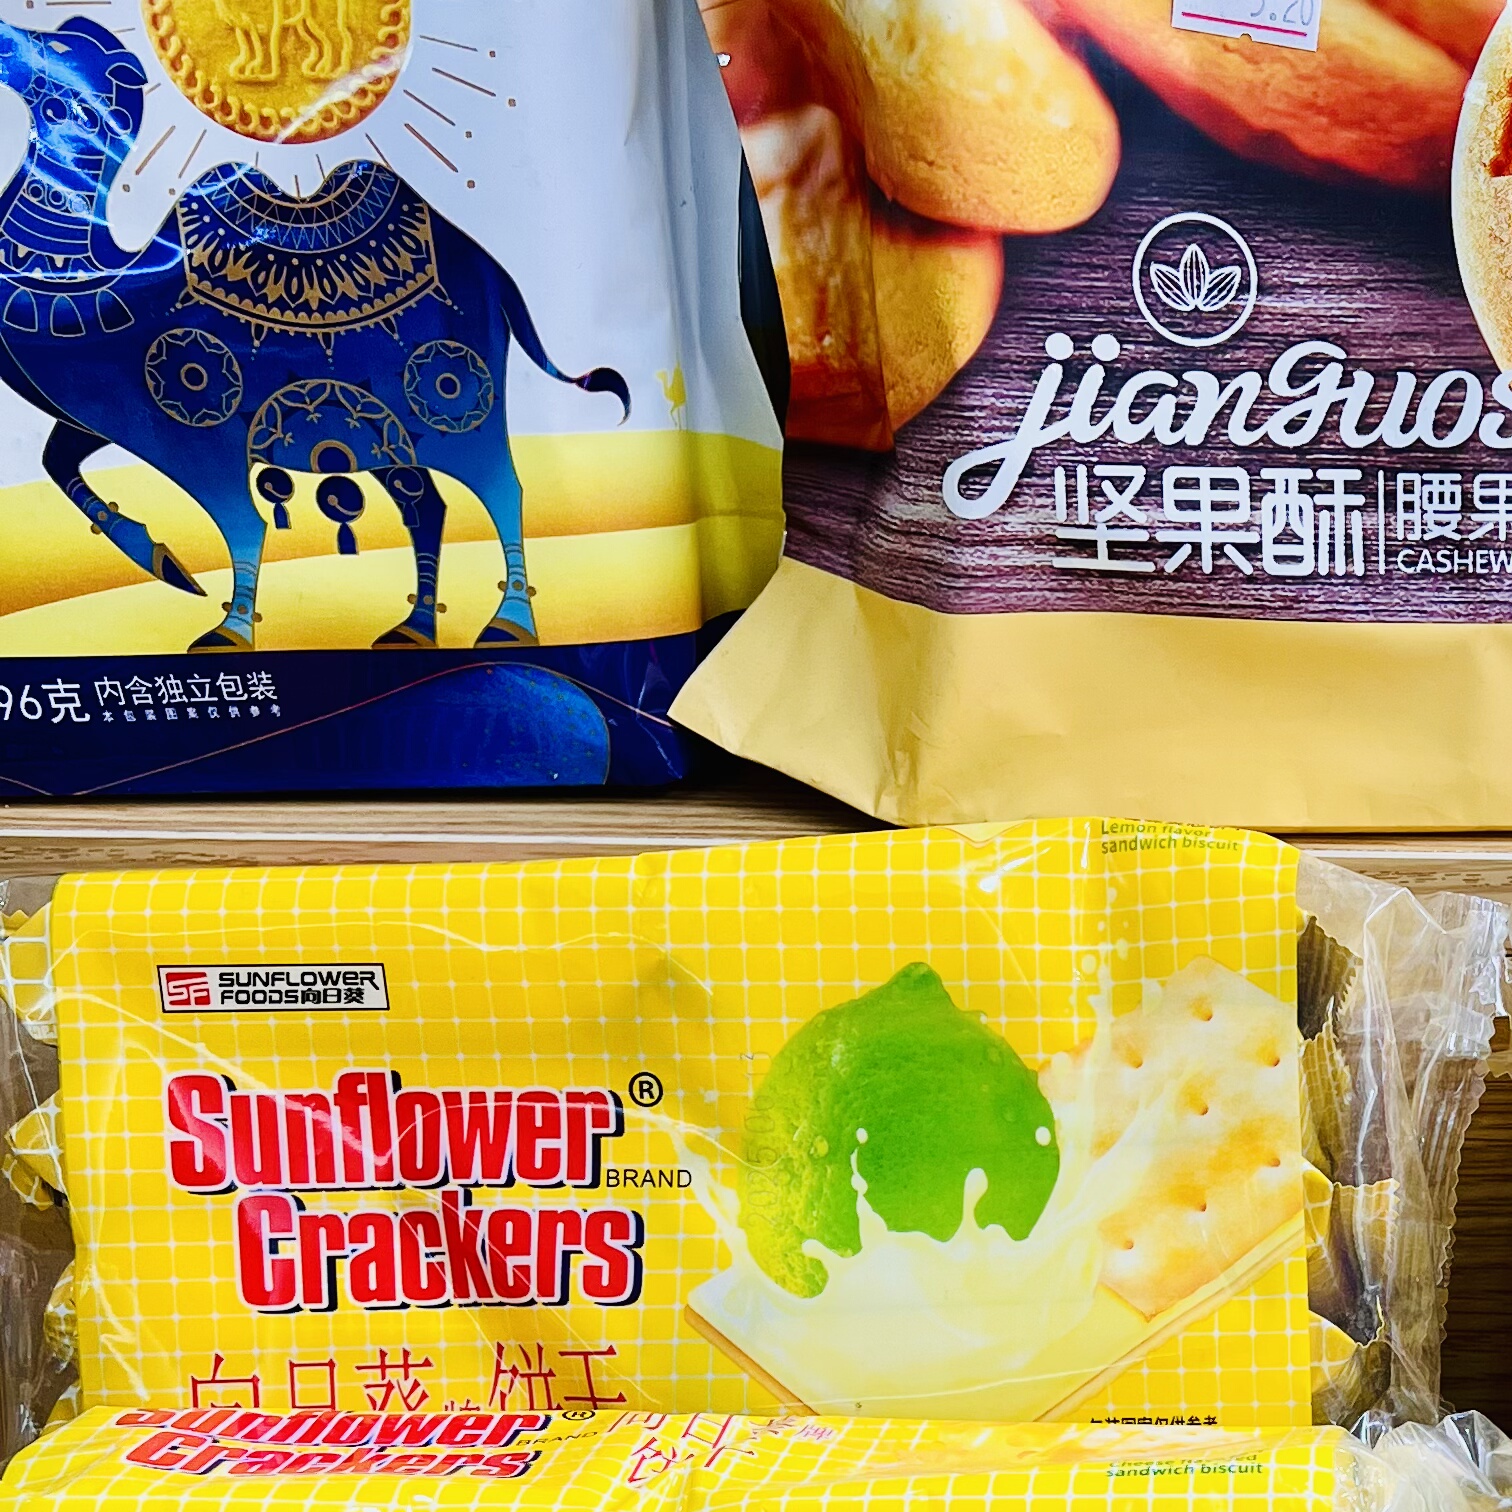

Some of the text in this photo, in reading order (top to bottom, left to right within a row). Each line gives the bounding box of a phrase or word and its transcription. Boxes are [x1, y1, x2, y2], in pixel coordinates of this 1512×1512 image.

[1249, 0, 1314, 26] .20
[1053, 464, 1363, 576] 坚果酥
[94, 671, 278, 706] 内含独立包装
[1101, 820, 1157, 835] Lemon
[1101, 834, 1239, 854] sandwich biscuit
[218, 970, 379, 990] SUNFLOWER
[166, 1069, 624, 1193] Sunflower
[605, 1168, 692, 1188] BRAND
[233, 1188, 643, 1312] Crackers
[116, 1409, 550, 1449] Sunflower
[515, 1431, 598, 1446] BRAND
[127, 1432, 541, 1479] Crackers
[1106, 1463, 1264, 1477] sandwich biscuit
